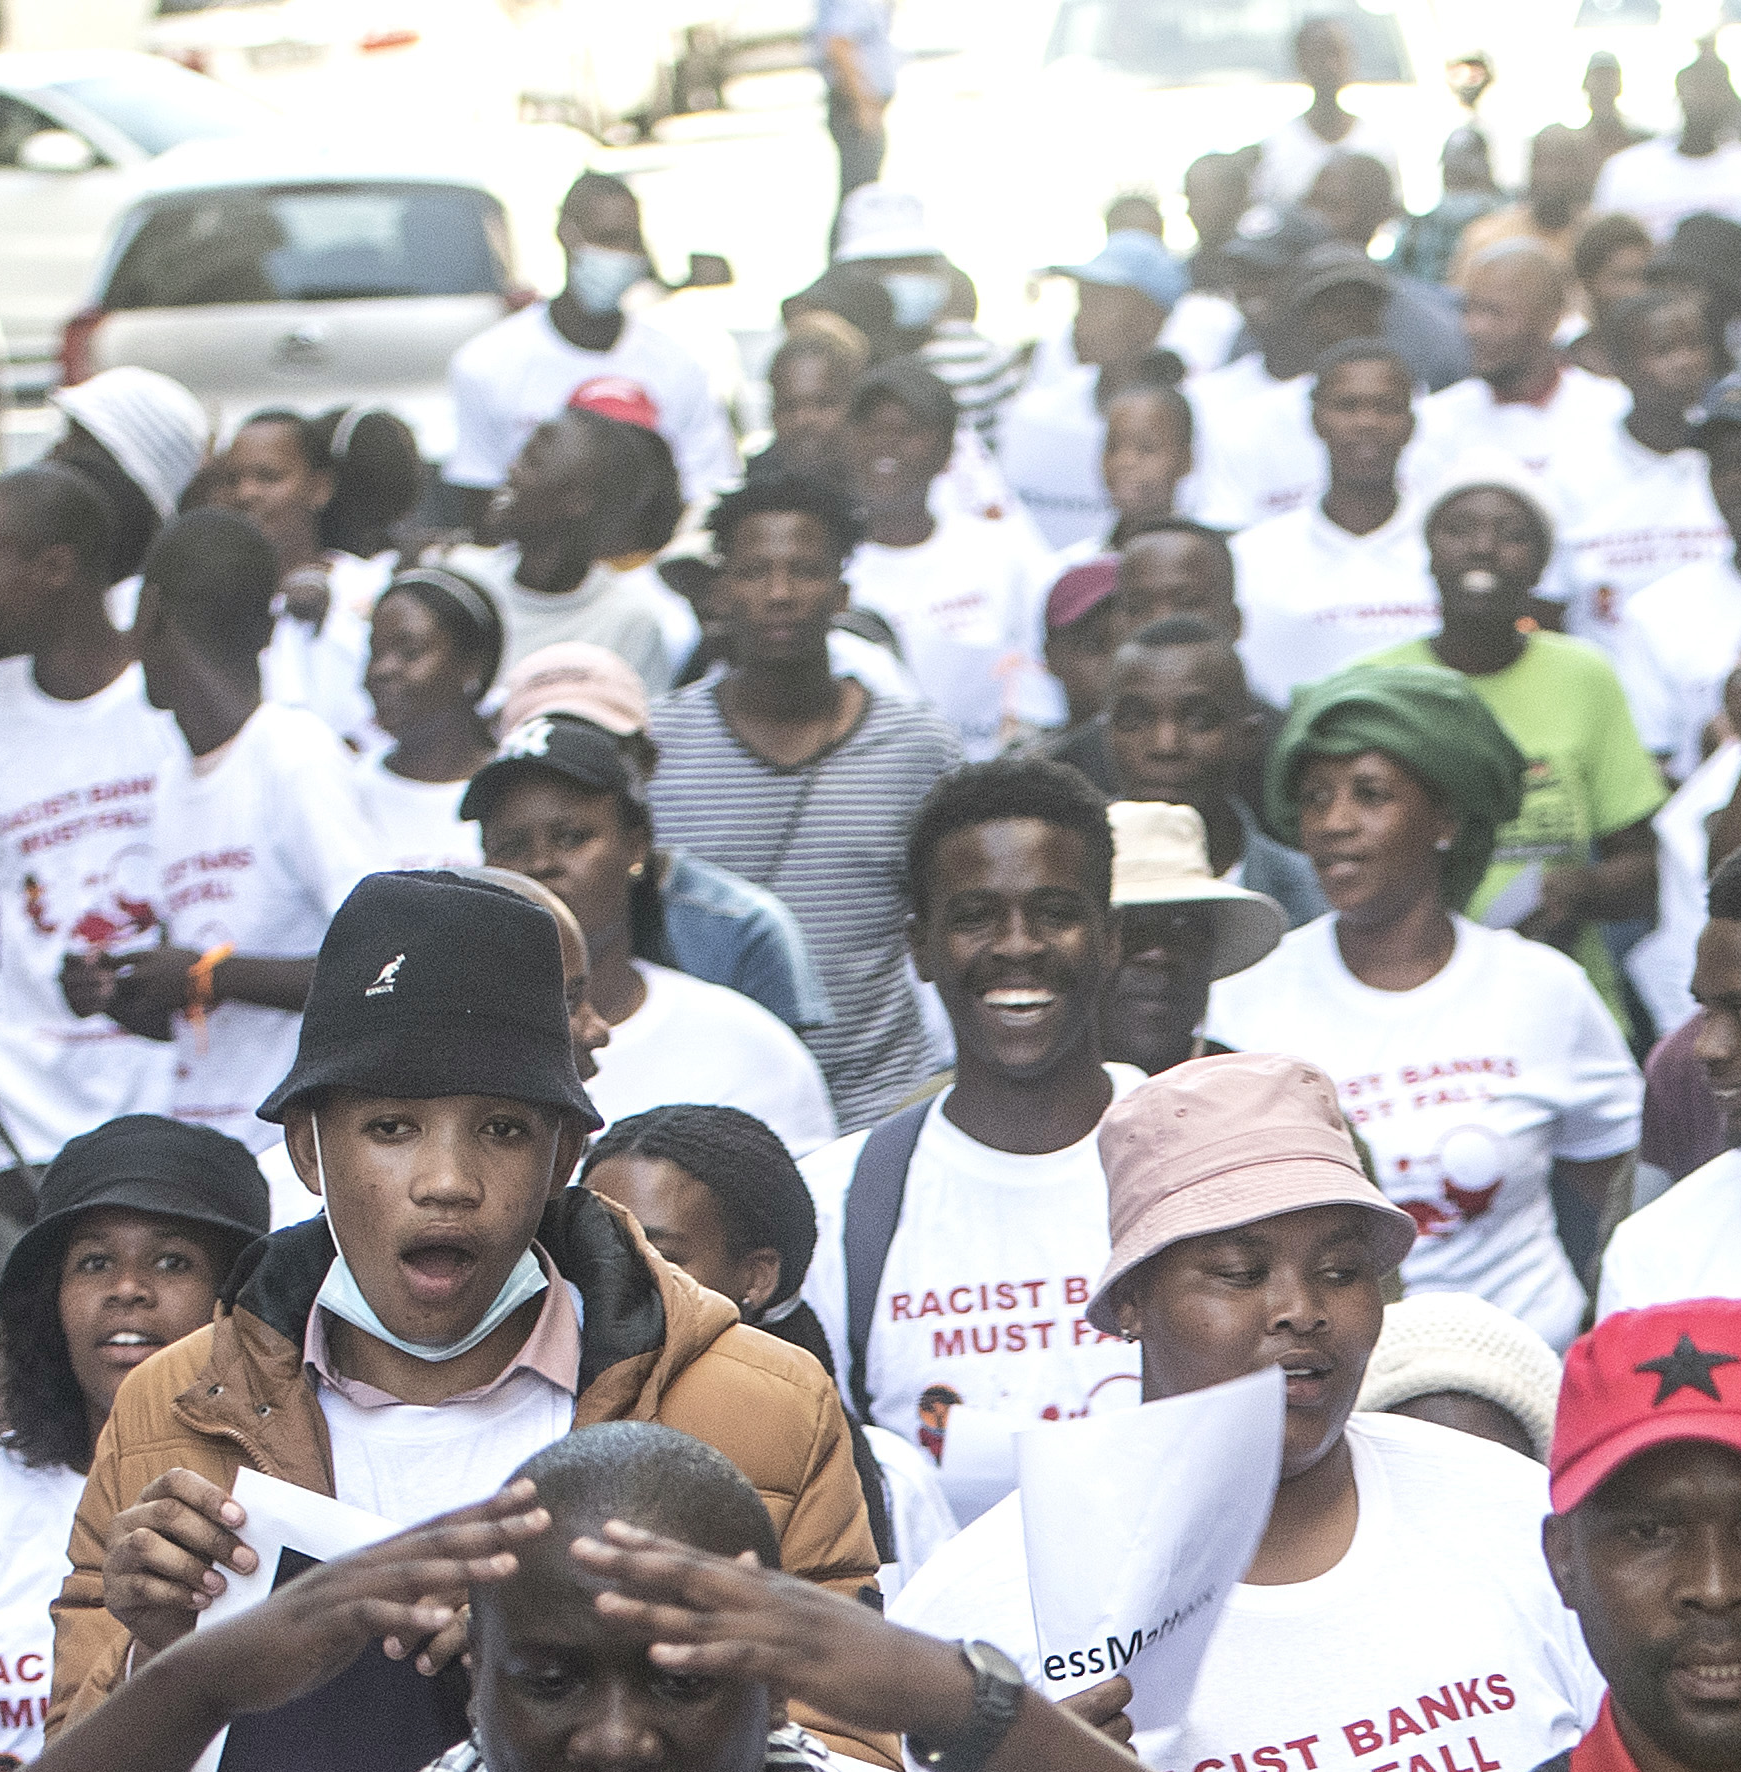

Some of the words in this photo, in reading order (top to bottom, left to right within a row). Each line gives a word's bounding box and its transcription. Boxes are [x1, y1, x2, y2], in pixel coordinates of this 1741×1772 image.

[891, 1280, 1049, 1322] RACIST
[932, 1321, 1055, 1359] MUST
[1342, 1672, 1516, 1758] BANKS
